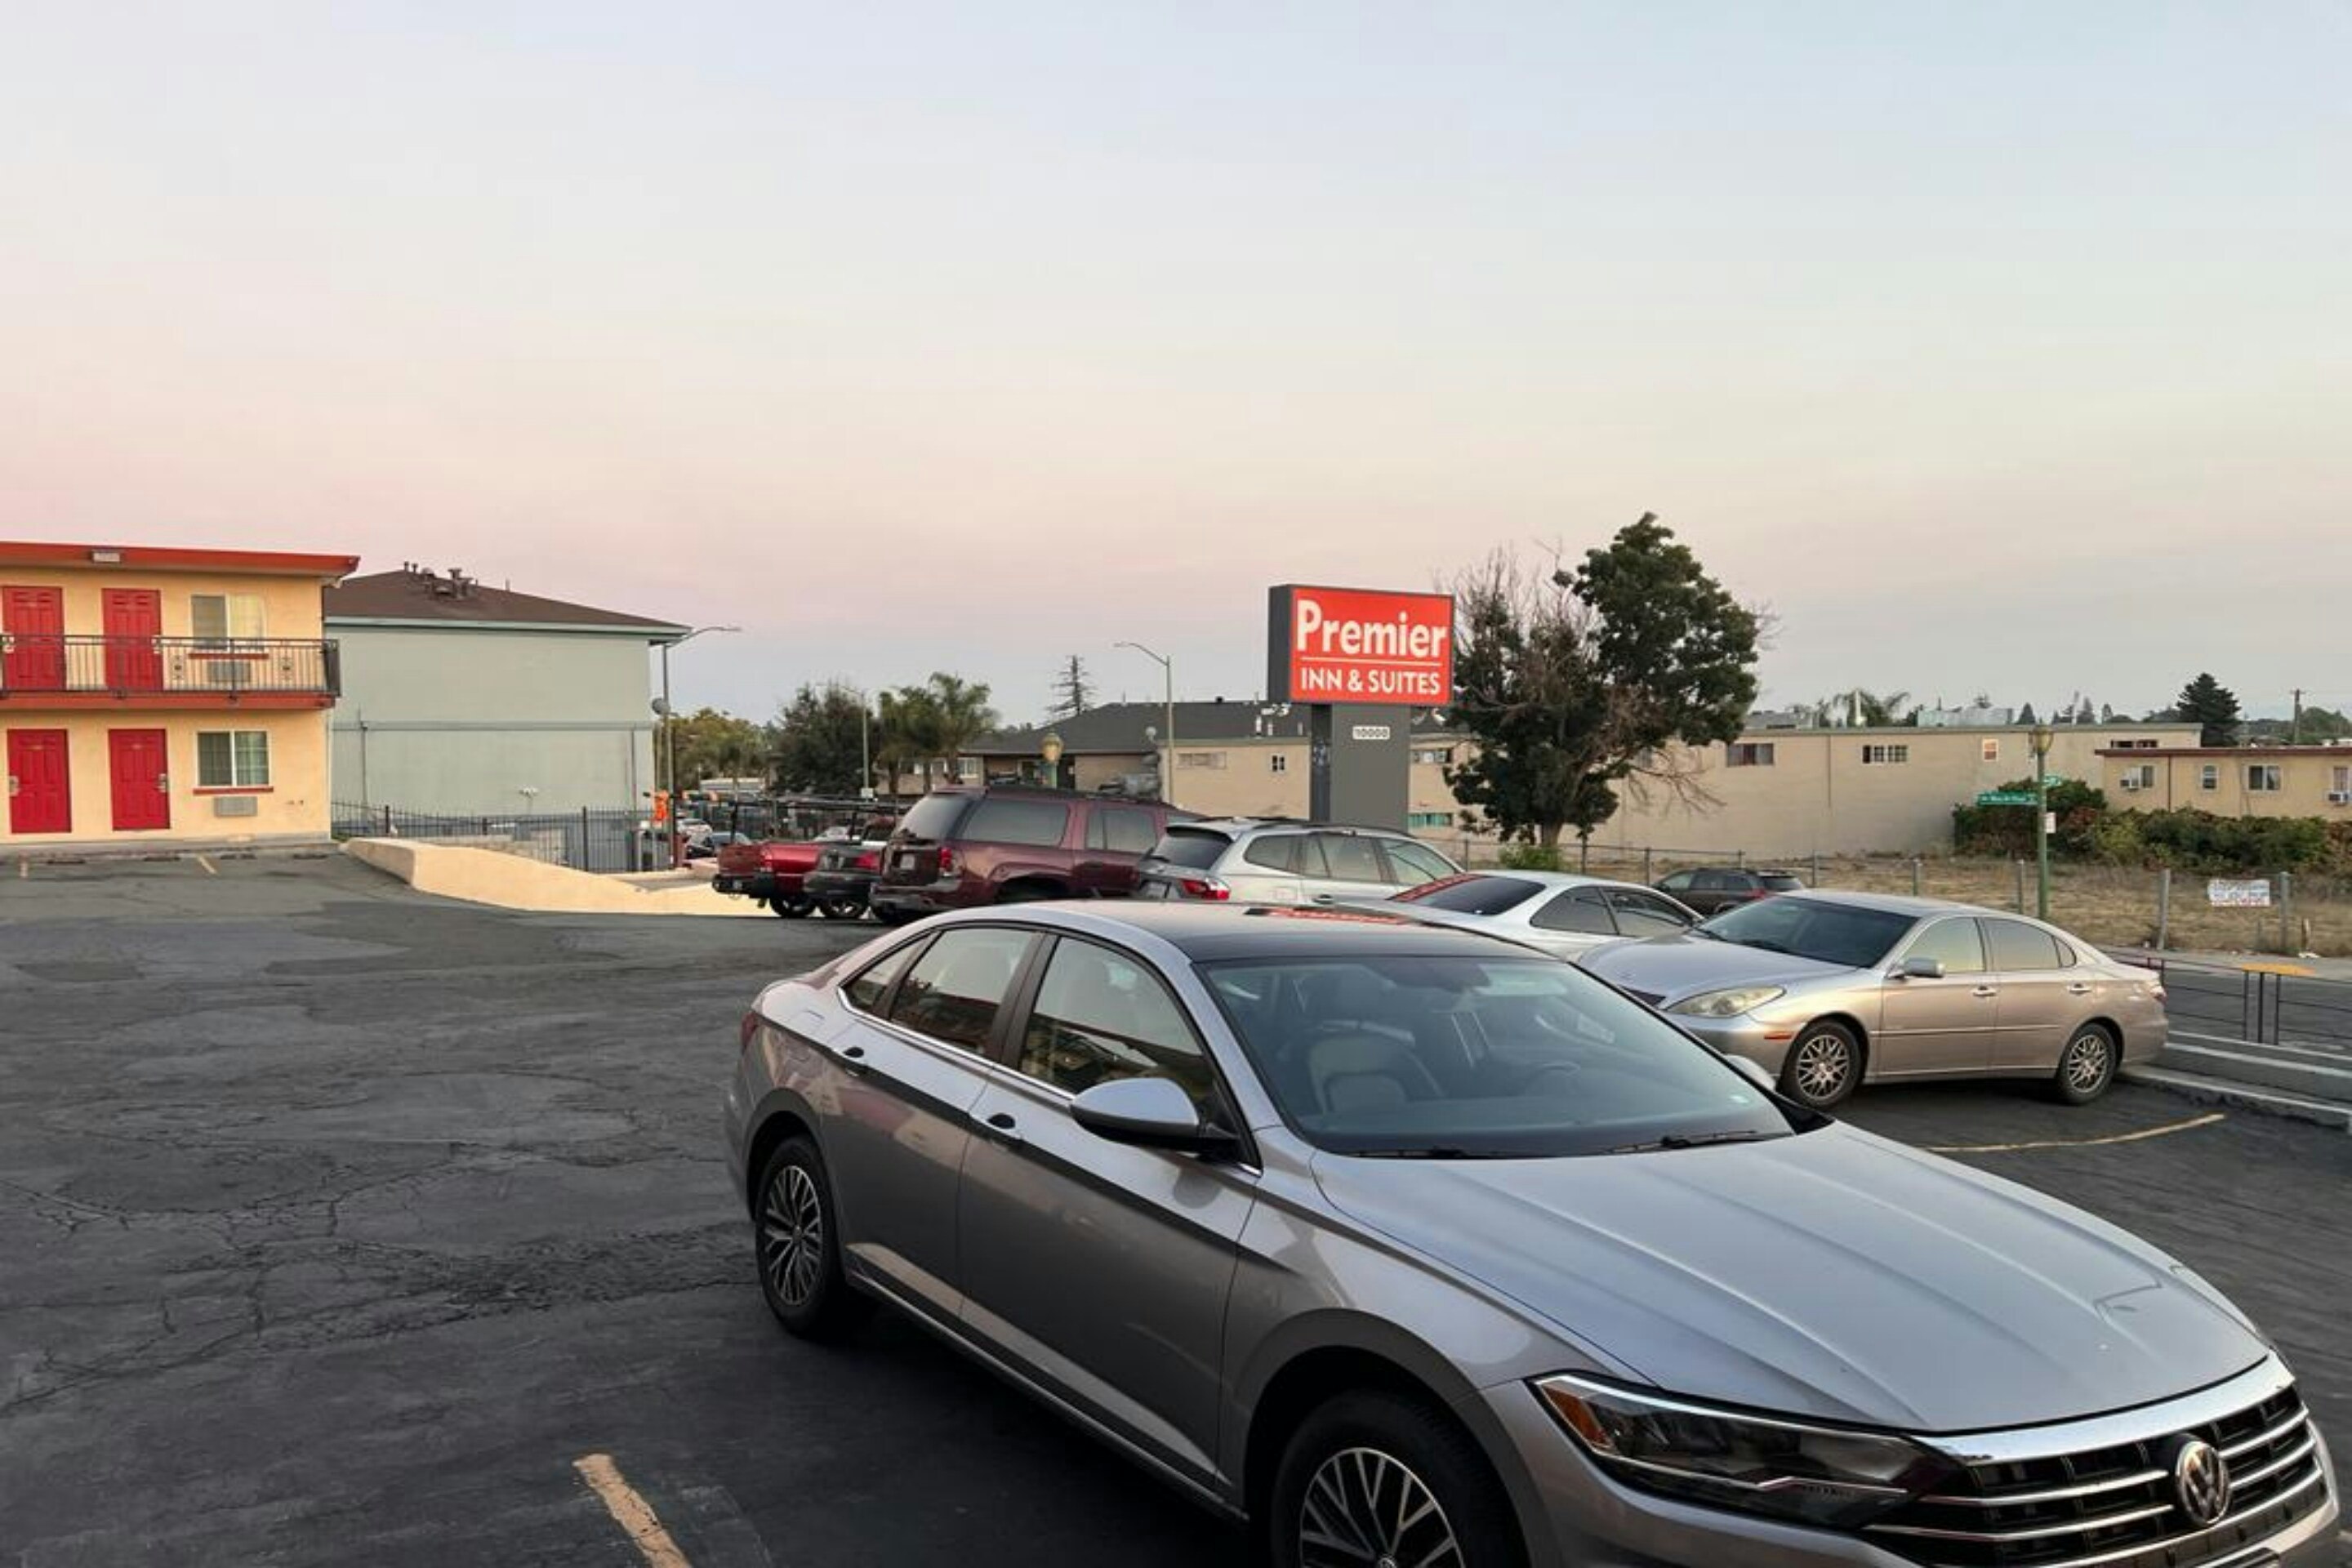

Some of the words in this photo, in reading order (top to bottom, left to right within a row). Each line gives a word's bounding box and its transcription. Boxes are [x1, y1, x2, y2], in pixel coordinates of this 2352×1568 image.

[1296, 599, 1447, 657] Premier
[1301, 667, 1343, 691] INN
[1347, 669, 1364, 692] &
[1368, 670, 1441, 695] SUITES
